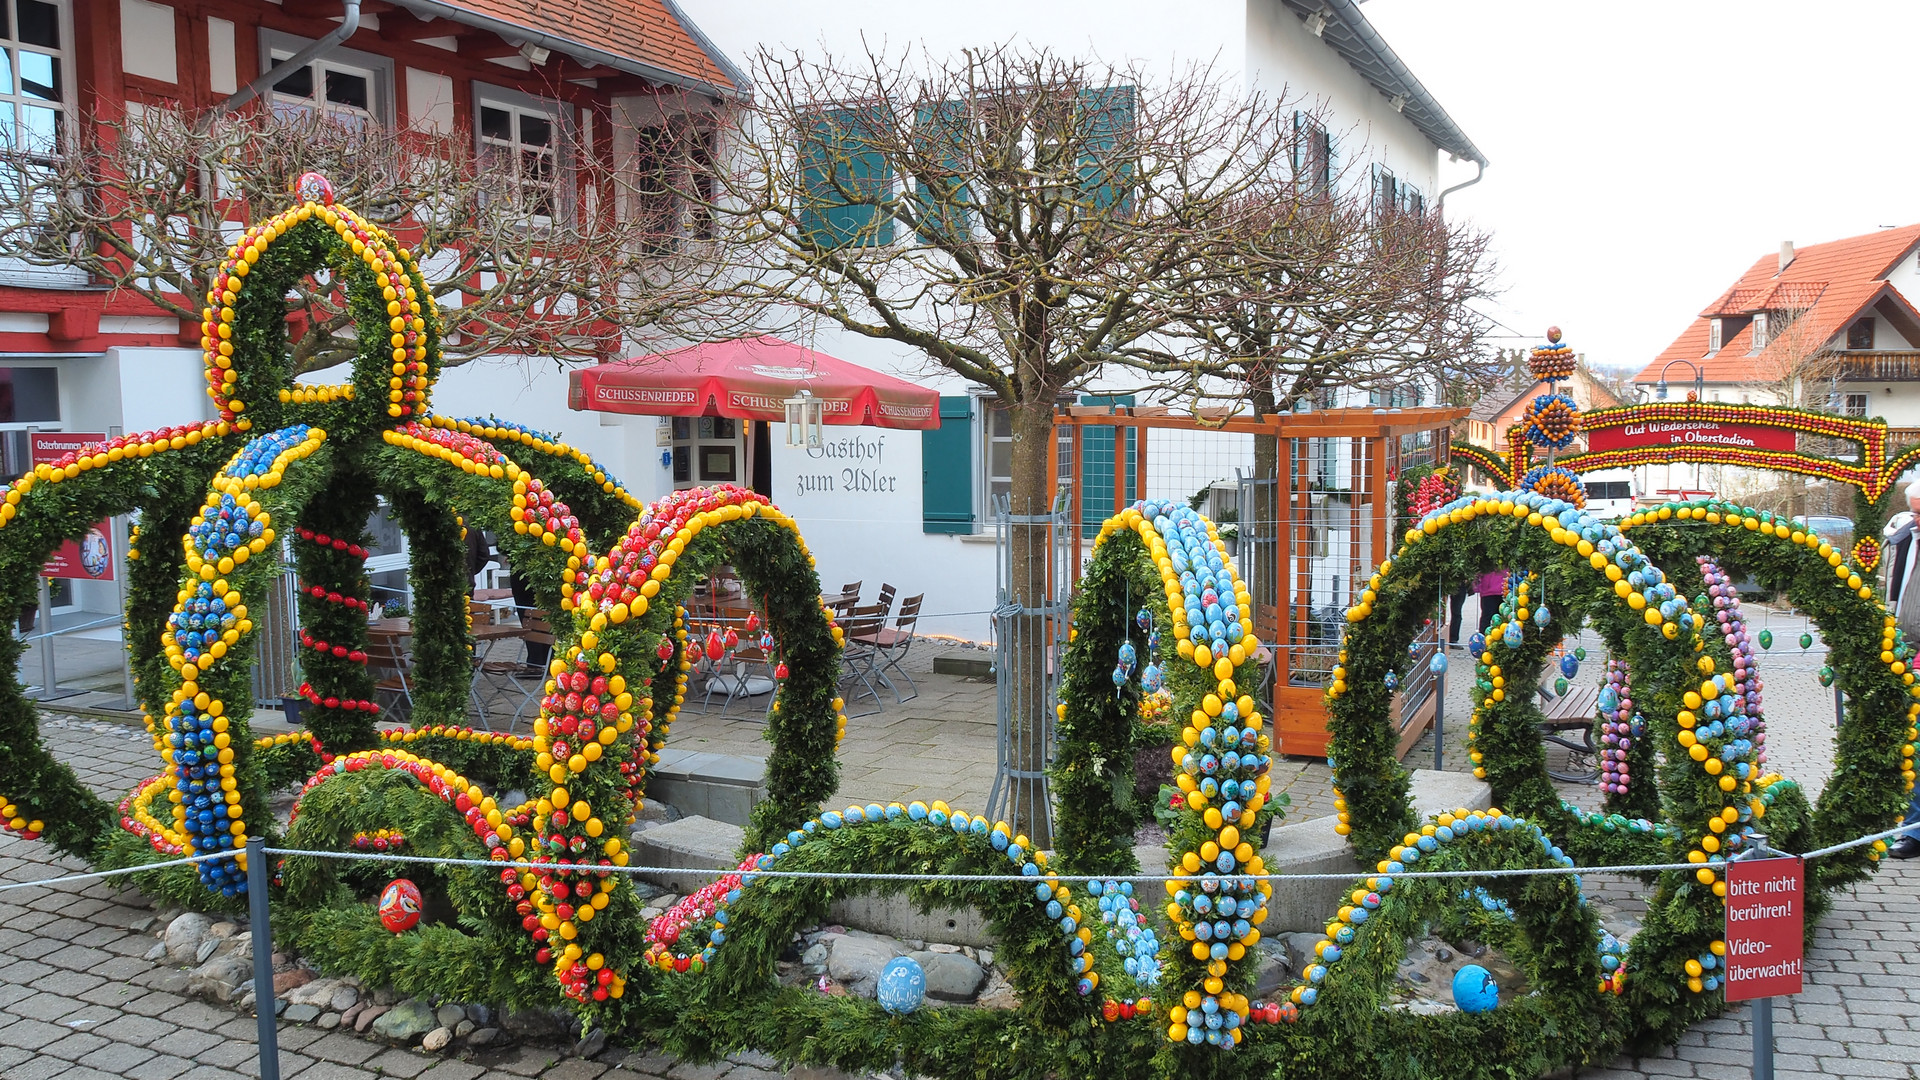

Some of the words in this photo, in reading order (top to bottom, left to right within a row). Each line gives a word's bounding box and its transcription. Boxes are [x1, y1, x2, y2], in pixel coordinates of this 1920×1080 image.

[598, 388, 695, 402] SCHUSSENRIEDER
[1625, 424, 1645, 436] Auf
[1649, 421, 1720, 433] Wiedersehen
[1671, 434, 1683, 443] in
[1685, 431, 1755, 446] Oberstadion
[37, 440, 82, 450] Osterbrunnen
[806, 435, 885, 464] Gasthof
[797, 474, 834, 496] zum
[841, 468, 896, 493] Adler
[1730, 879, 1760, 896] bitte
[1764, 875, 1797, 893] nicht
[1729, 900, 1791, 922] berühren!
[1728, 937, 1772, 956] Video-
[1729, 958, 1801, 982] überwacht!
